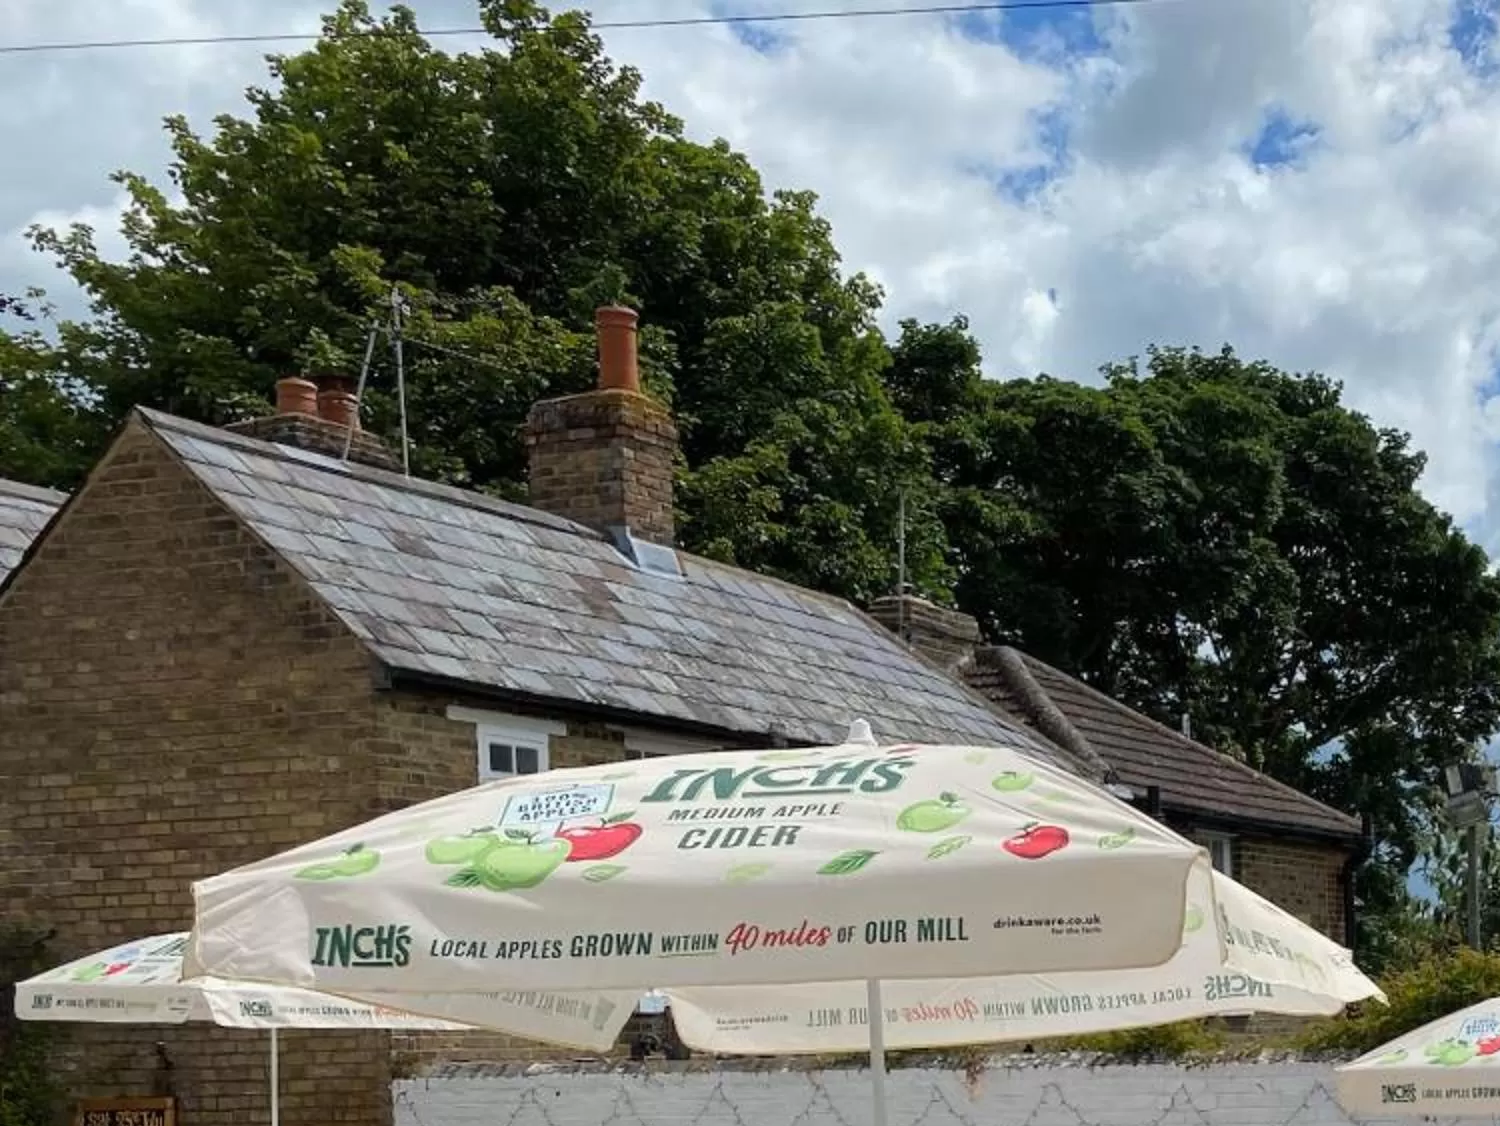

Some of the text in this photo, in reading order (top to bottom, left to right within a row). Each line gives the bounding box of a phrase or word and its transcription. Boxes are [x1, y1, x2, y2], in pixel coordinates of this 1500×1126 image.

[668, 802, 844, 821] MEDIUM APPLE
[677, 825, 804, 850] CIDER
[993, 912, 1101, 929] drinkaware.co.uk
[430, 939, 488, 959] LOCAL
[496, 940, 562, 959] APPLES
[570, 931, 653, 957] GROWN
[661, 932, 718, 952] WITHIN
[725, 921, 759, 955] 40
[762, 919, 832, 947] miles
[837, 925, 856, 943] OF
[865, 919, 907, 944] OUR
[917, 916, 969, 943] MILL
